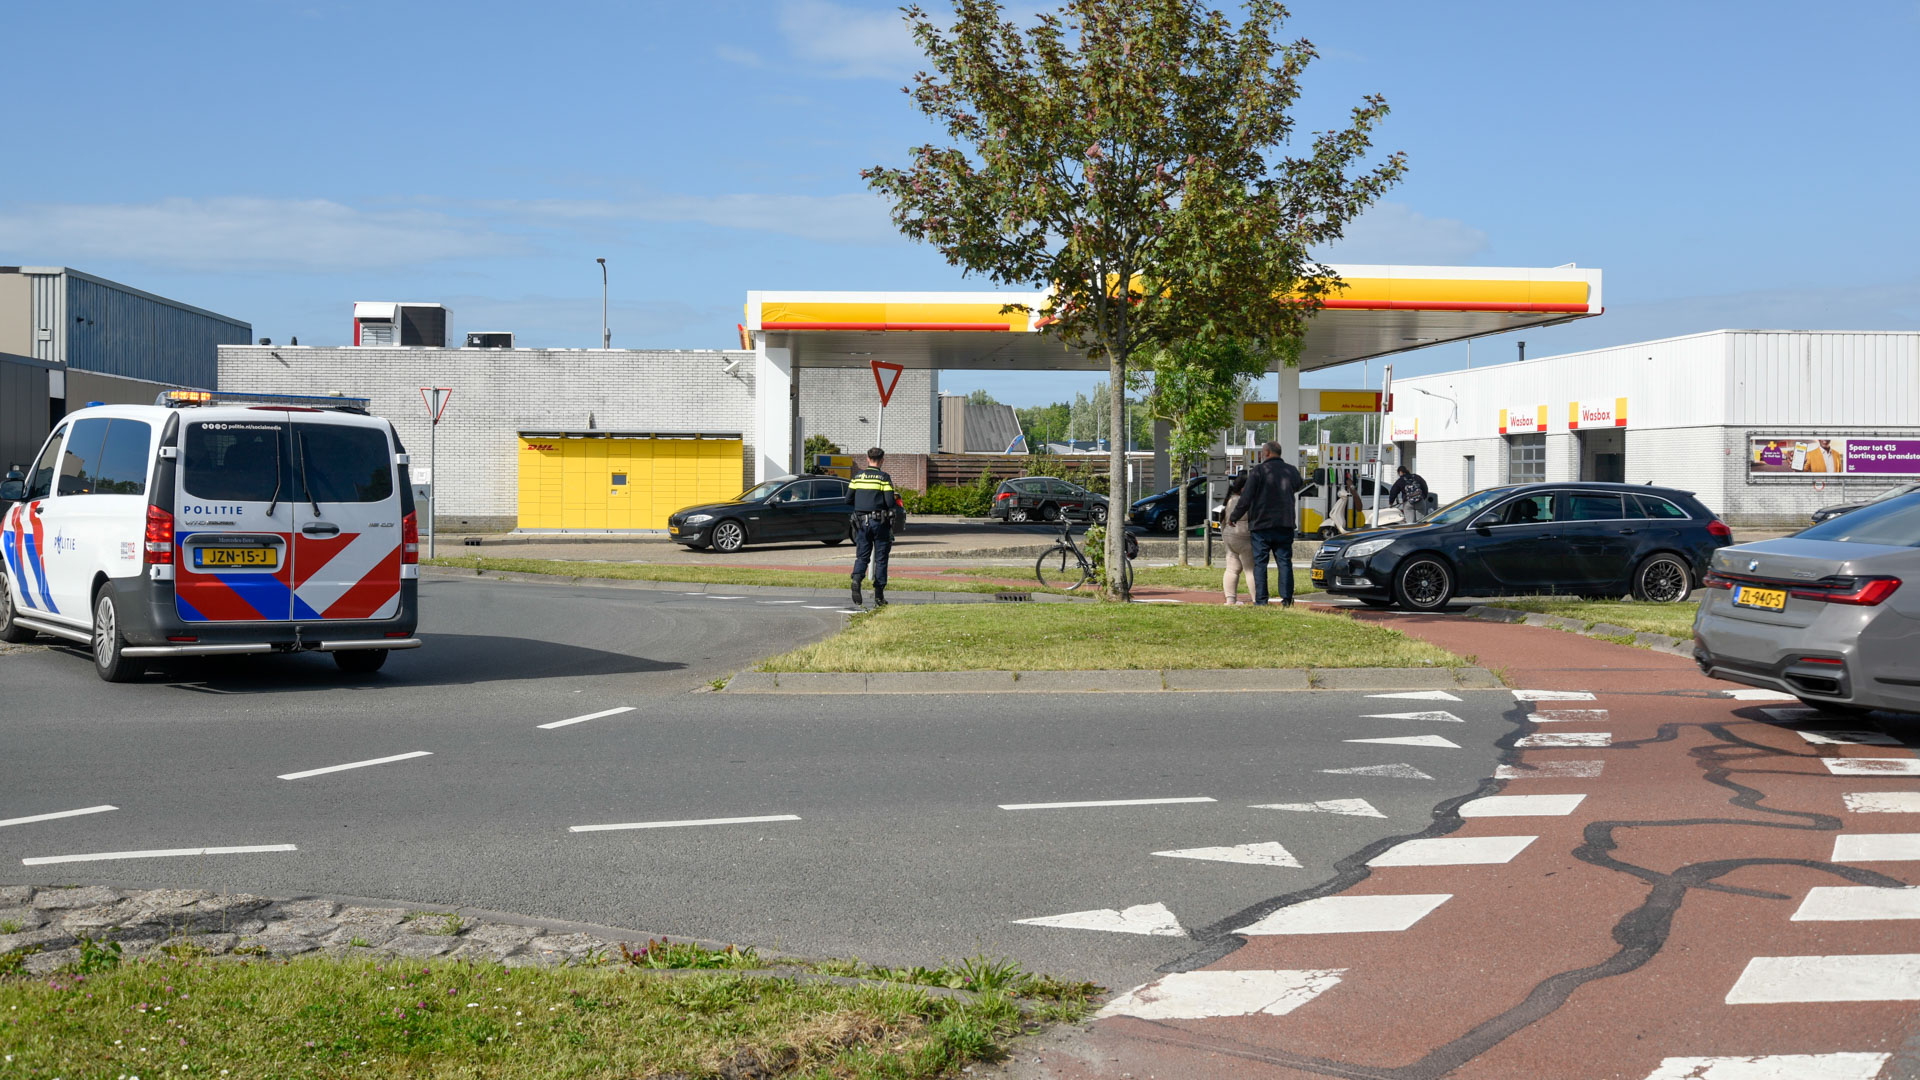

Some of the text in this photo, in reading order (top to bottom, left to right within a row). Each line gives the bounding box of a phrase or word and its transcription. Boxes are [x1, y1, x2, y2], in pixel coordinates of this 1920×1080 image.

[1510, 415, 1534, 427] Wasbox
[1582, 408, 1611, 422] Wasbox
[1848, 444, 1870, 452] Spaar
[1884, 444, 1897, 452] €15
[1848, 451, 1920, 461] korting op brandsto
[184, 505, 243, 515] POLITIE
[209, 550, 267, 563] JZN-15-J
[1740, 589, 1782, 607] ZL-940-S
